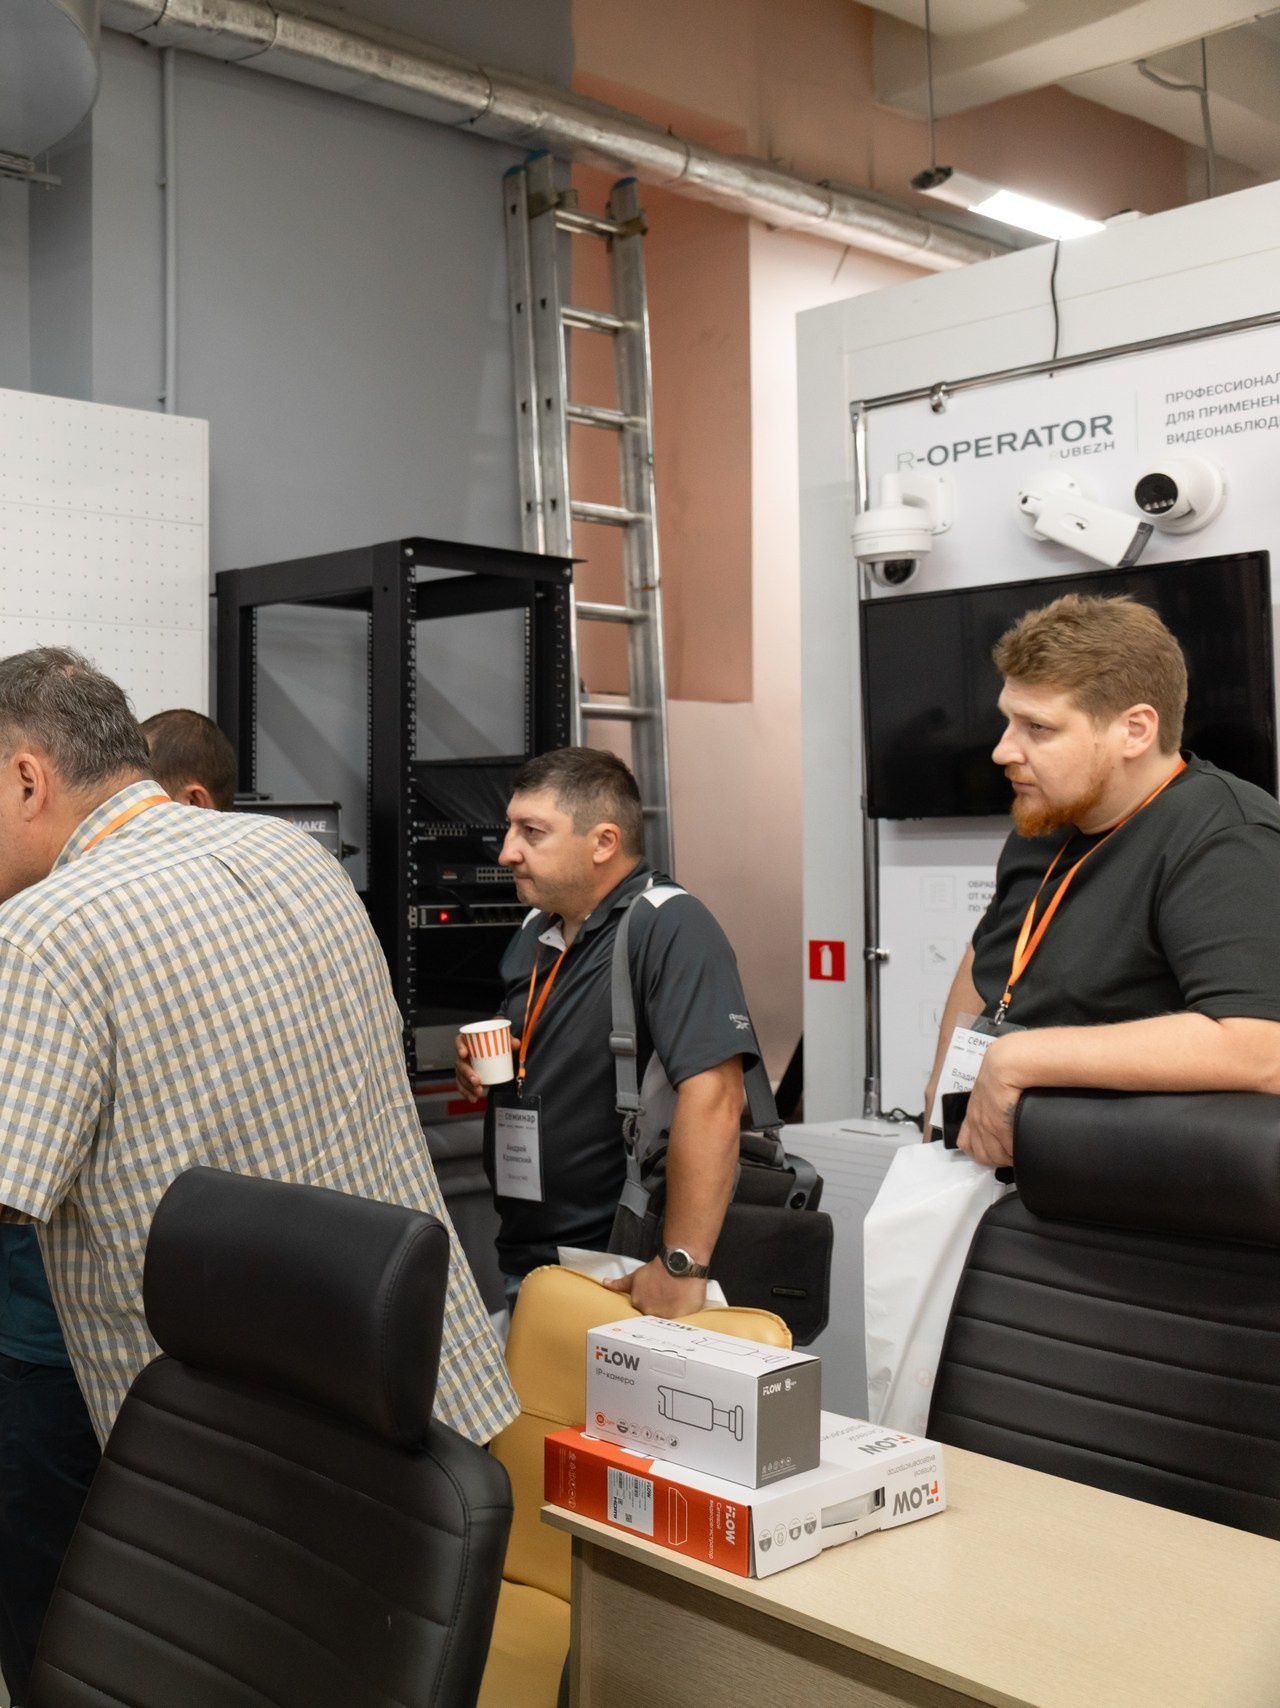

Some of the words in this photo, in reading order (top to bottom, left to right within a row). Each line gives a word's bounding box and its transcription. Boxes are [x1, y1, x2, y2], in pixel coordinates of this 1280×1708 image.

[1166, 410, 1195, 426] ДЛЯ
[1166, 416, 1280, 445] ВИДЕОНАБЛЮД
[897, 414, 1114, 472] R-OPERATOR
[504, 1112, 536, 1124] семинар
